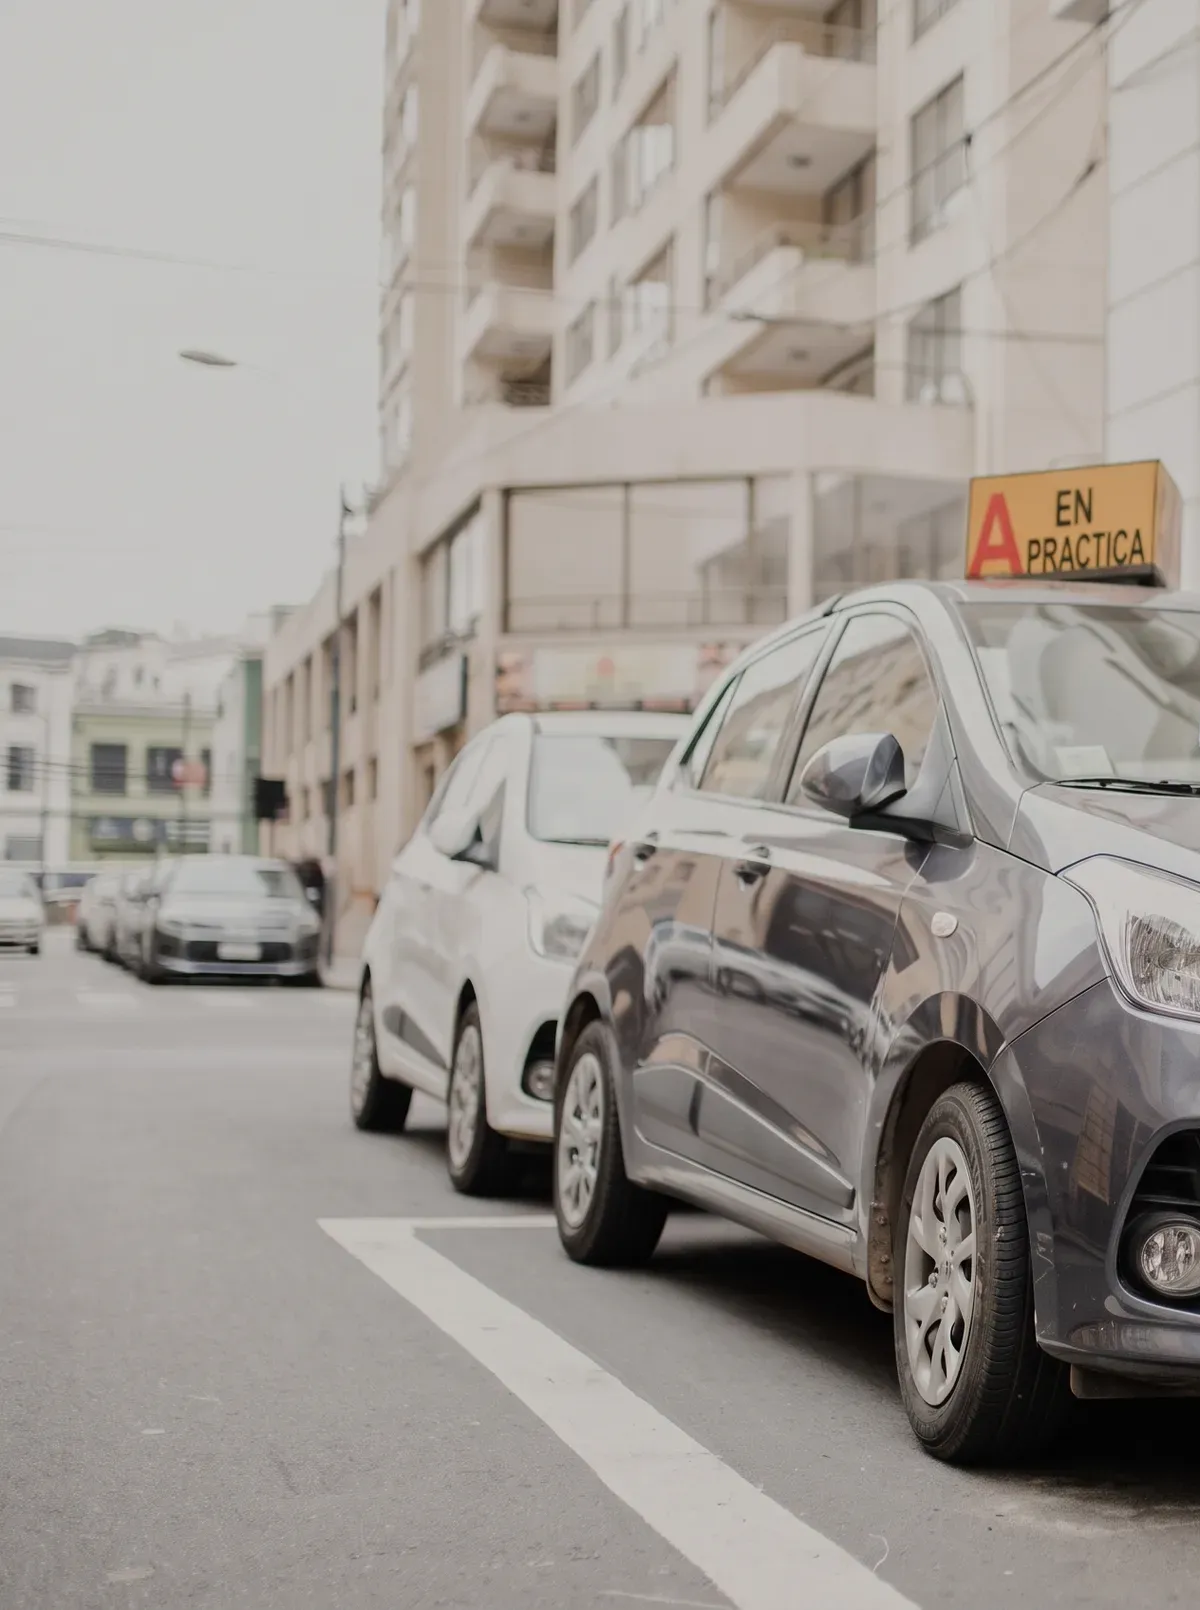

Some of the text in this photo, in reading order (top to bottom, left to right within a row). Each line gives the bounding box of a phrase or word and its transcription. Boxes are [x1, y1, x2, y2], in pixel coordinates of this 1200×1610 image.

[1055, 487, 1093, 527] EN
[968, 492, 1024, 578] A
[1026, 529, 1145, 575] PRACTICA
